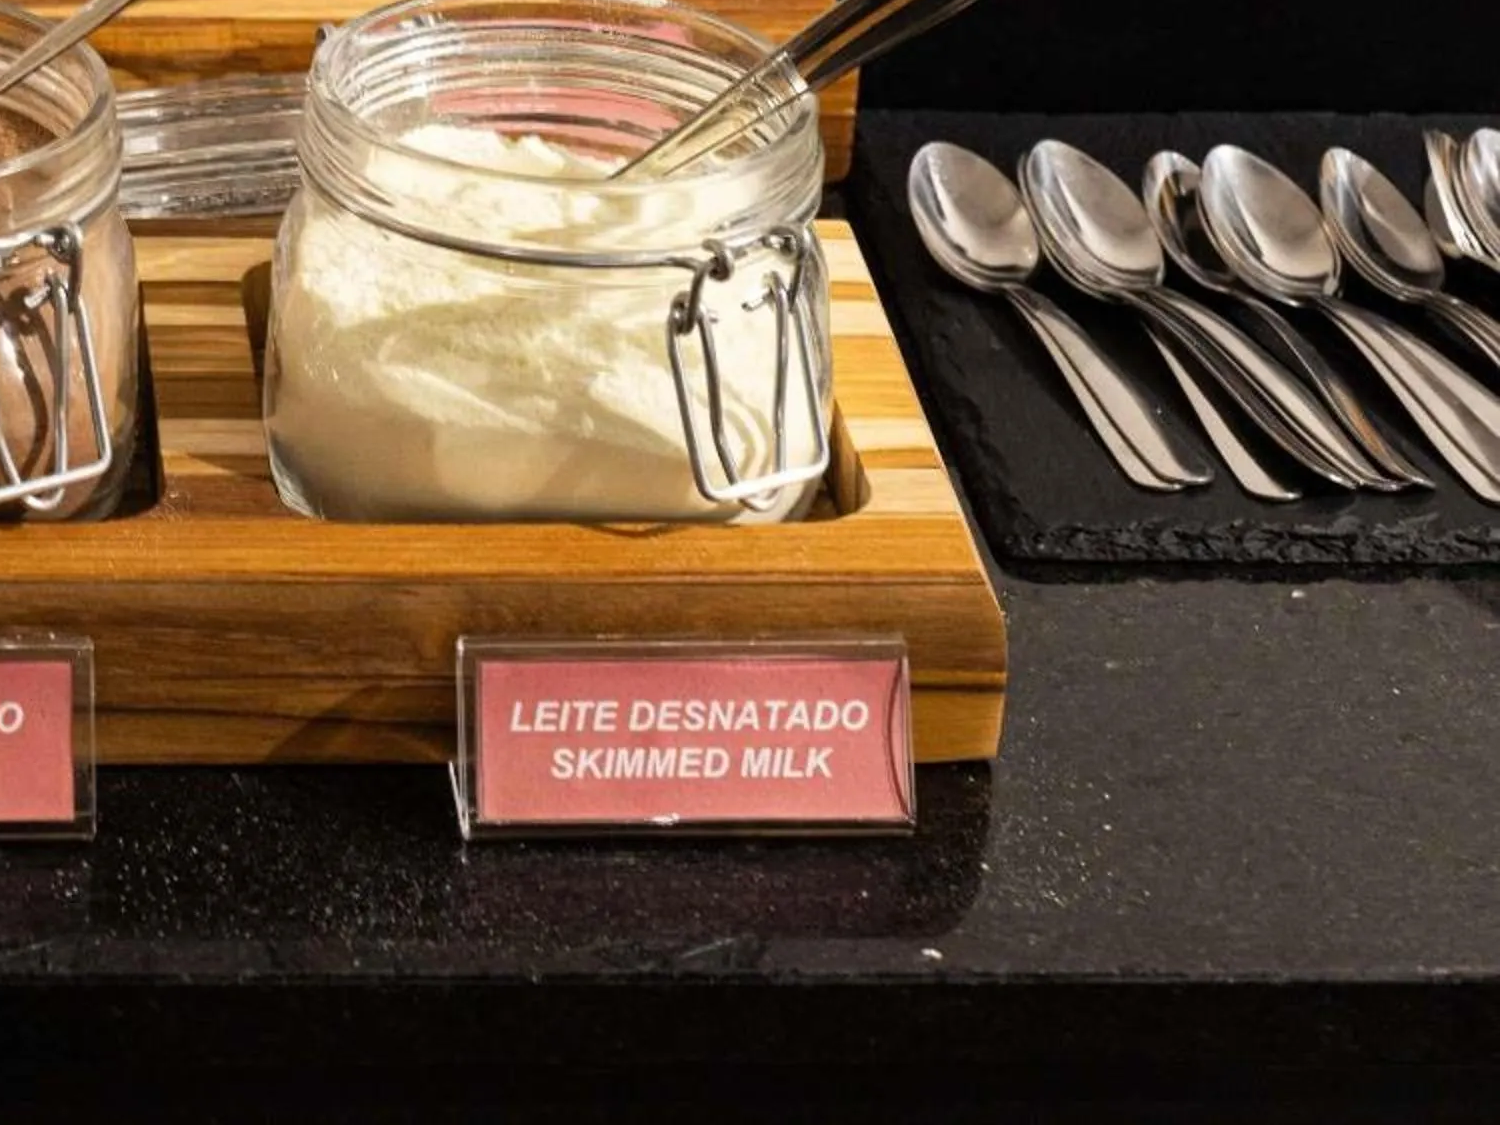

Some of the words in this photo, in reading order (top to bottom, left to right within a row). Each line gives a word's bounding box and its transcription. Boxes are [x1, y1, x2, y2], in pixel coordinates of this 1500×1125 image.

[510, 700, 619, 732] LEITE
[629, 700, 869, 731] DESNATADO
[551, 747, 730, 779] SKIMMED
[741, 747, 833, 778] MILK
